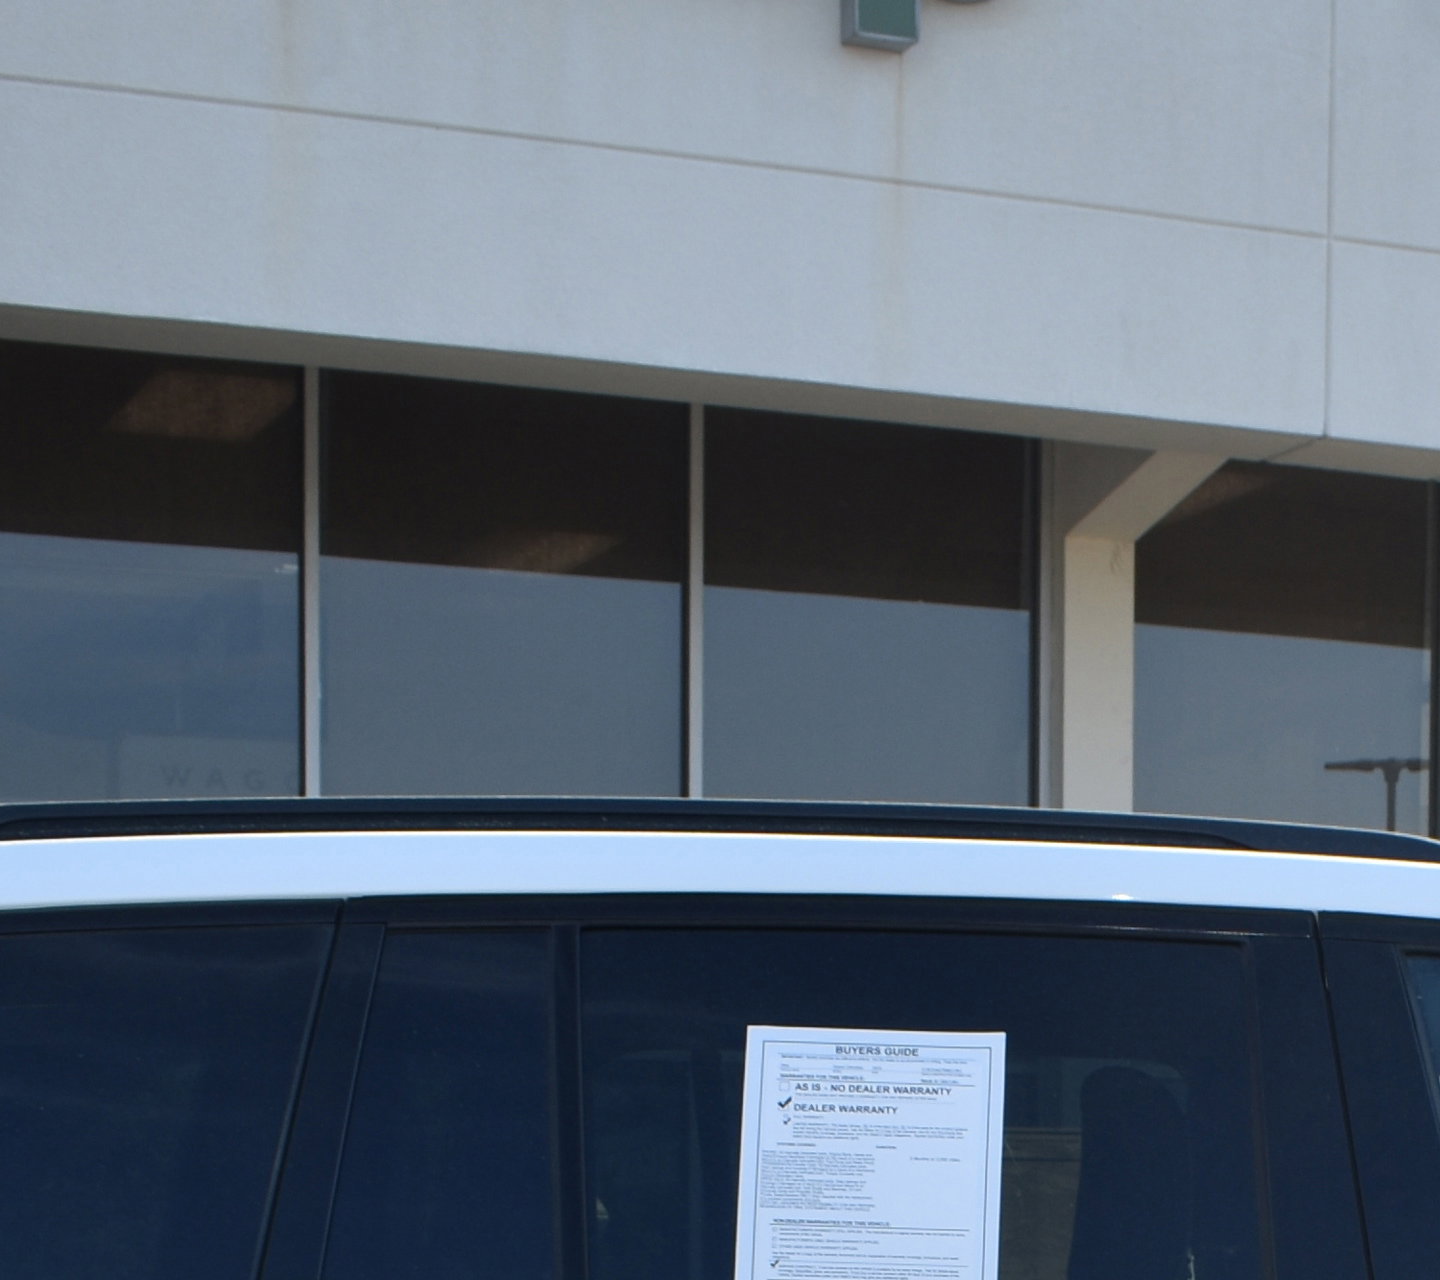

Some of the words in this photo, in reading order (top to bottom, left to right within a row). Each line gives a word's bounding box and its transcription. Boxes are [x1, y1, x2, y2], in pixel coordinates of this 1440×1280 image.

[835, 1045, 881, 1056] BUYERS
[884, 1046, 919, 1057] GUIDE
[795, 1083, 809, 1091] AS
[811, 1083, 821, 1092] IS
[830, 1084, 846, 1093] NO
[848, 1084, 891, 1094] DEALER
[893, 1086, 952, 1096] WARRANTY
[793, 1104, 836, 1113] DEALER
[838, 1105, 898, 1115] WARRANTY
